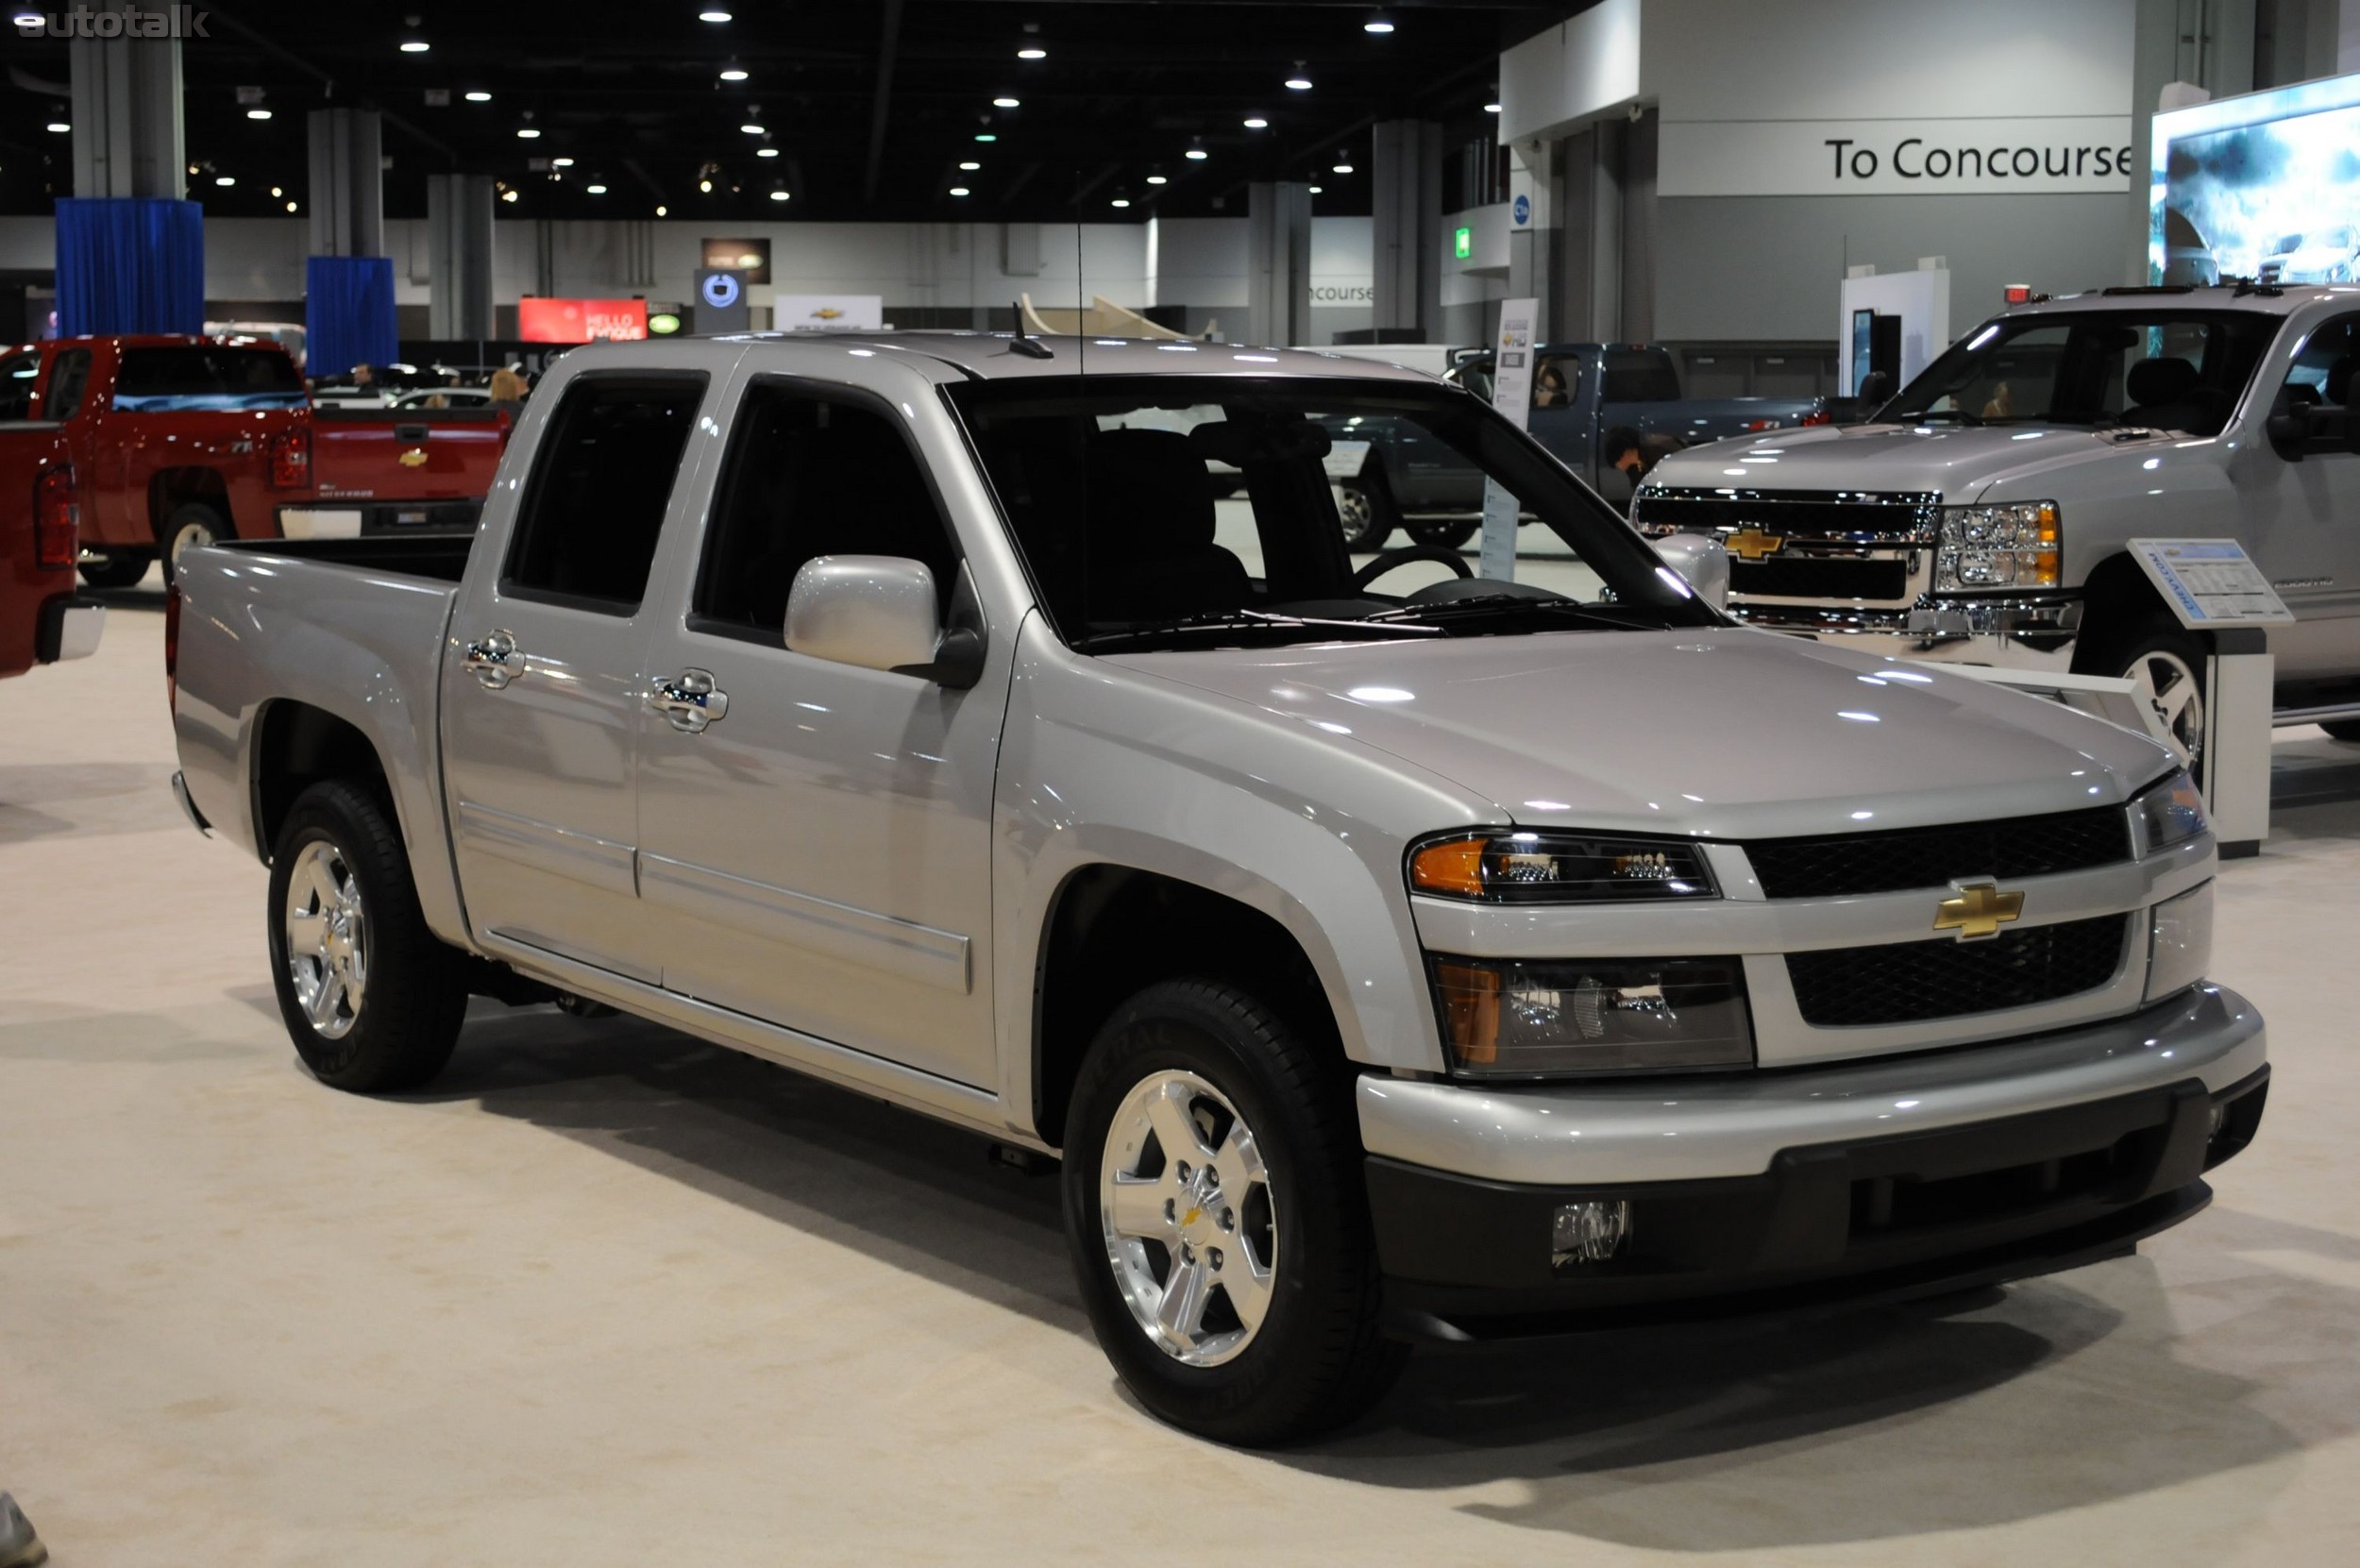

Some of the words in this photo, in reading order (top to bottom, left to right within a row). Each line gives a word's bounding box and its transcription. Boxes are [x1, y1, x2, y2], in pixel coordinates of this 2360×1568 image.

[1824, 139, 1879, 179] To
[1893, 138, 2131, 178] Concourse
[585, 313, 633, 327] HELLO
